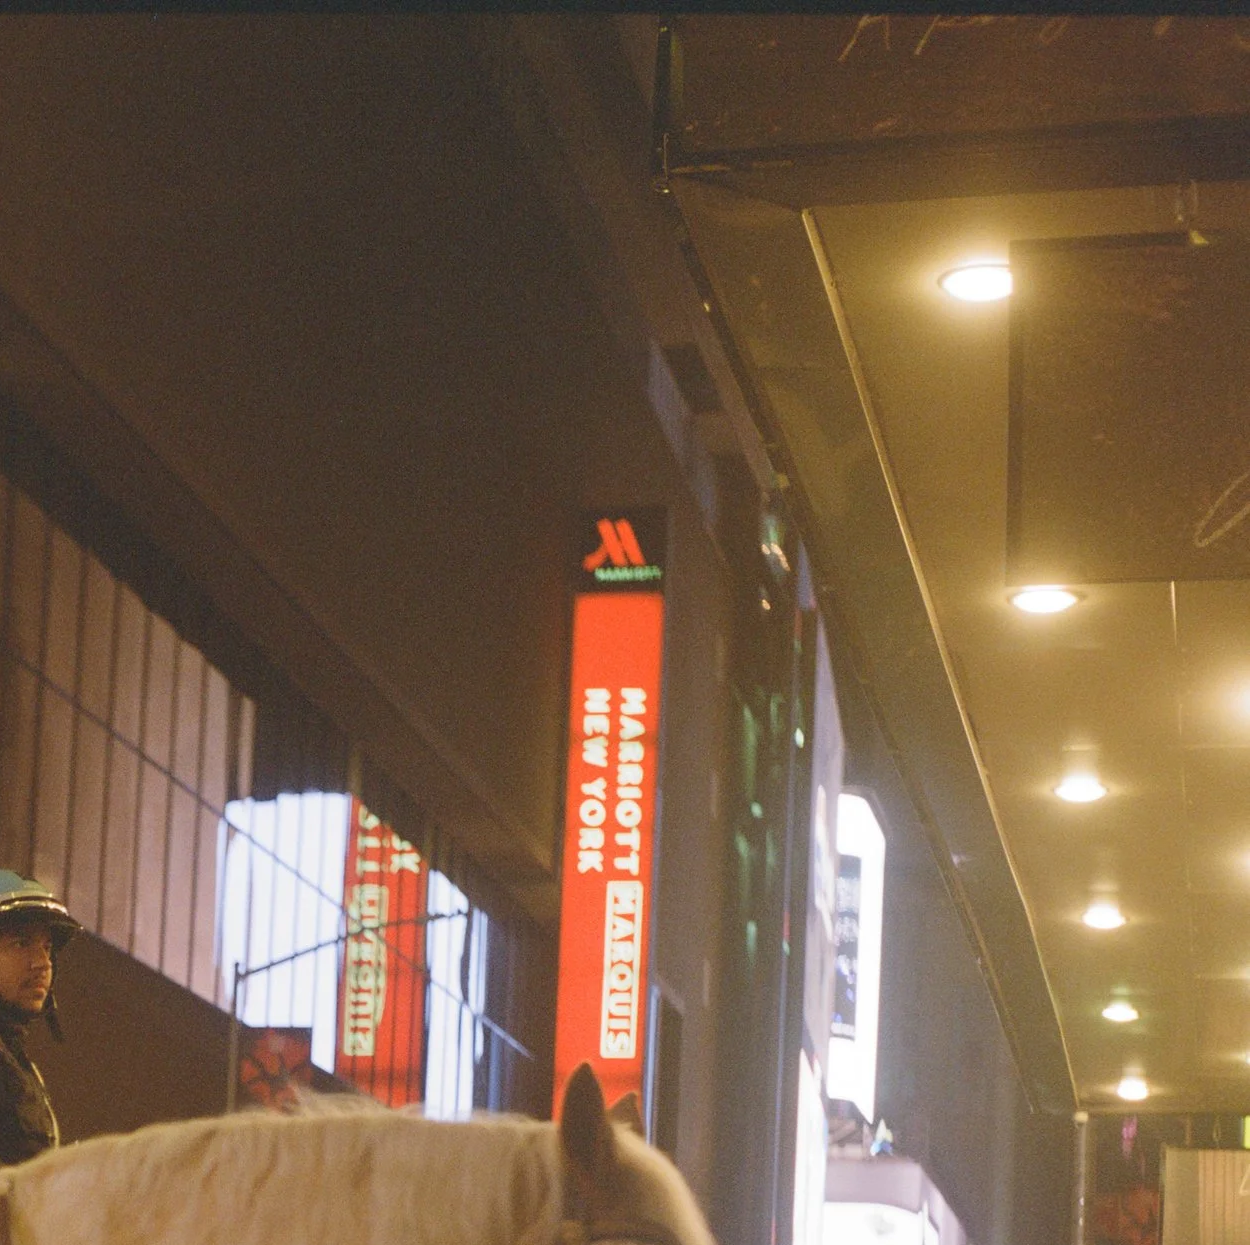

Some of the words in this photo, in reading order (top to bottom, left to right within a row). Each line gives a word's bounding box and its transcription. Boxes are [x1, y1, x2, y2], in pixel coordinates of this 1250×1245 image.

[582, 688, 611, 767] NEW
[613, 687, 647, 876] MARRIOTT
[577, 777, 607, 874] YORK
[606, 884, 637, 1055] MARQUIS
